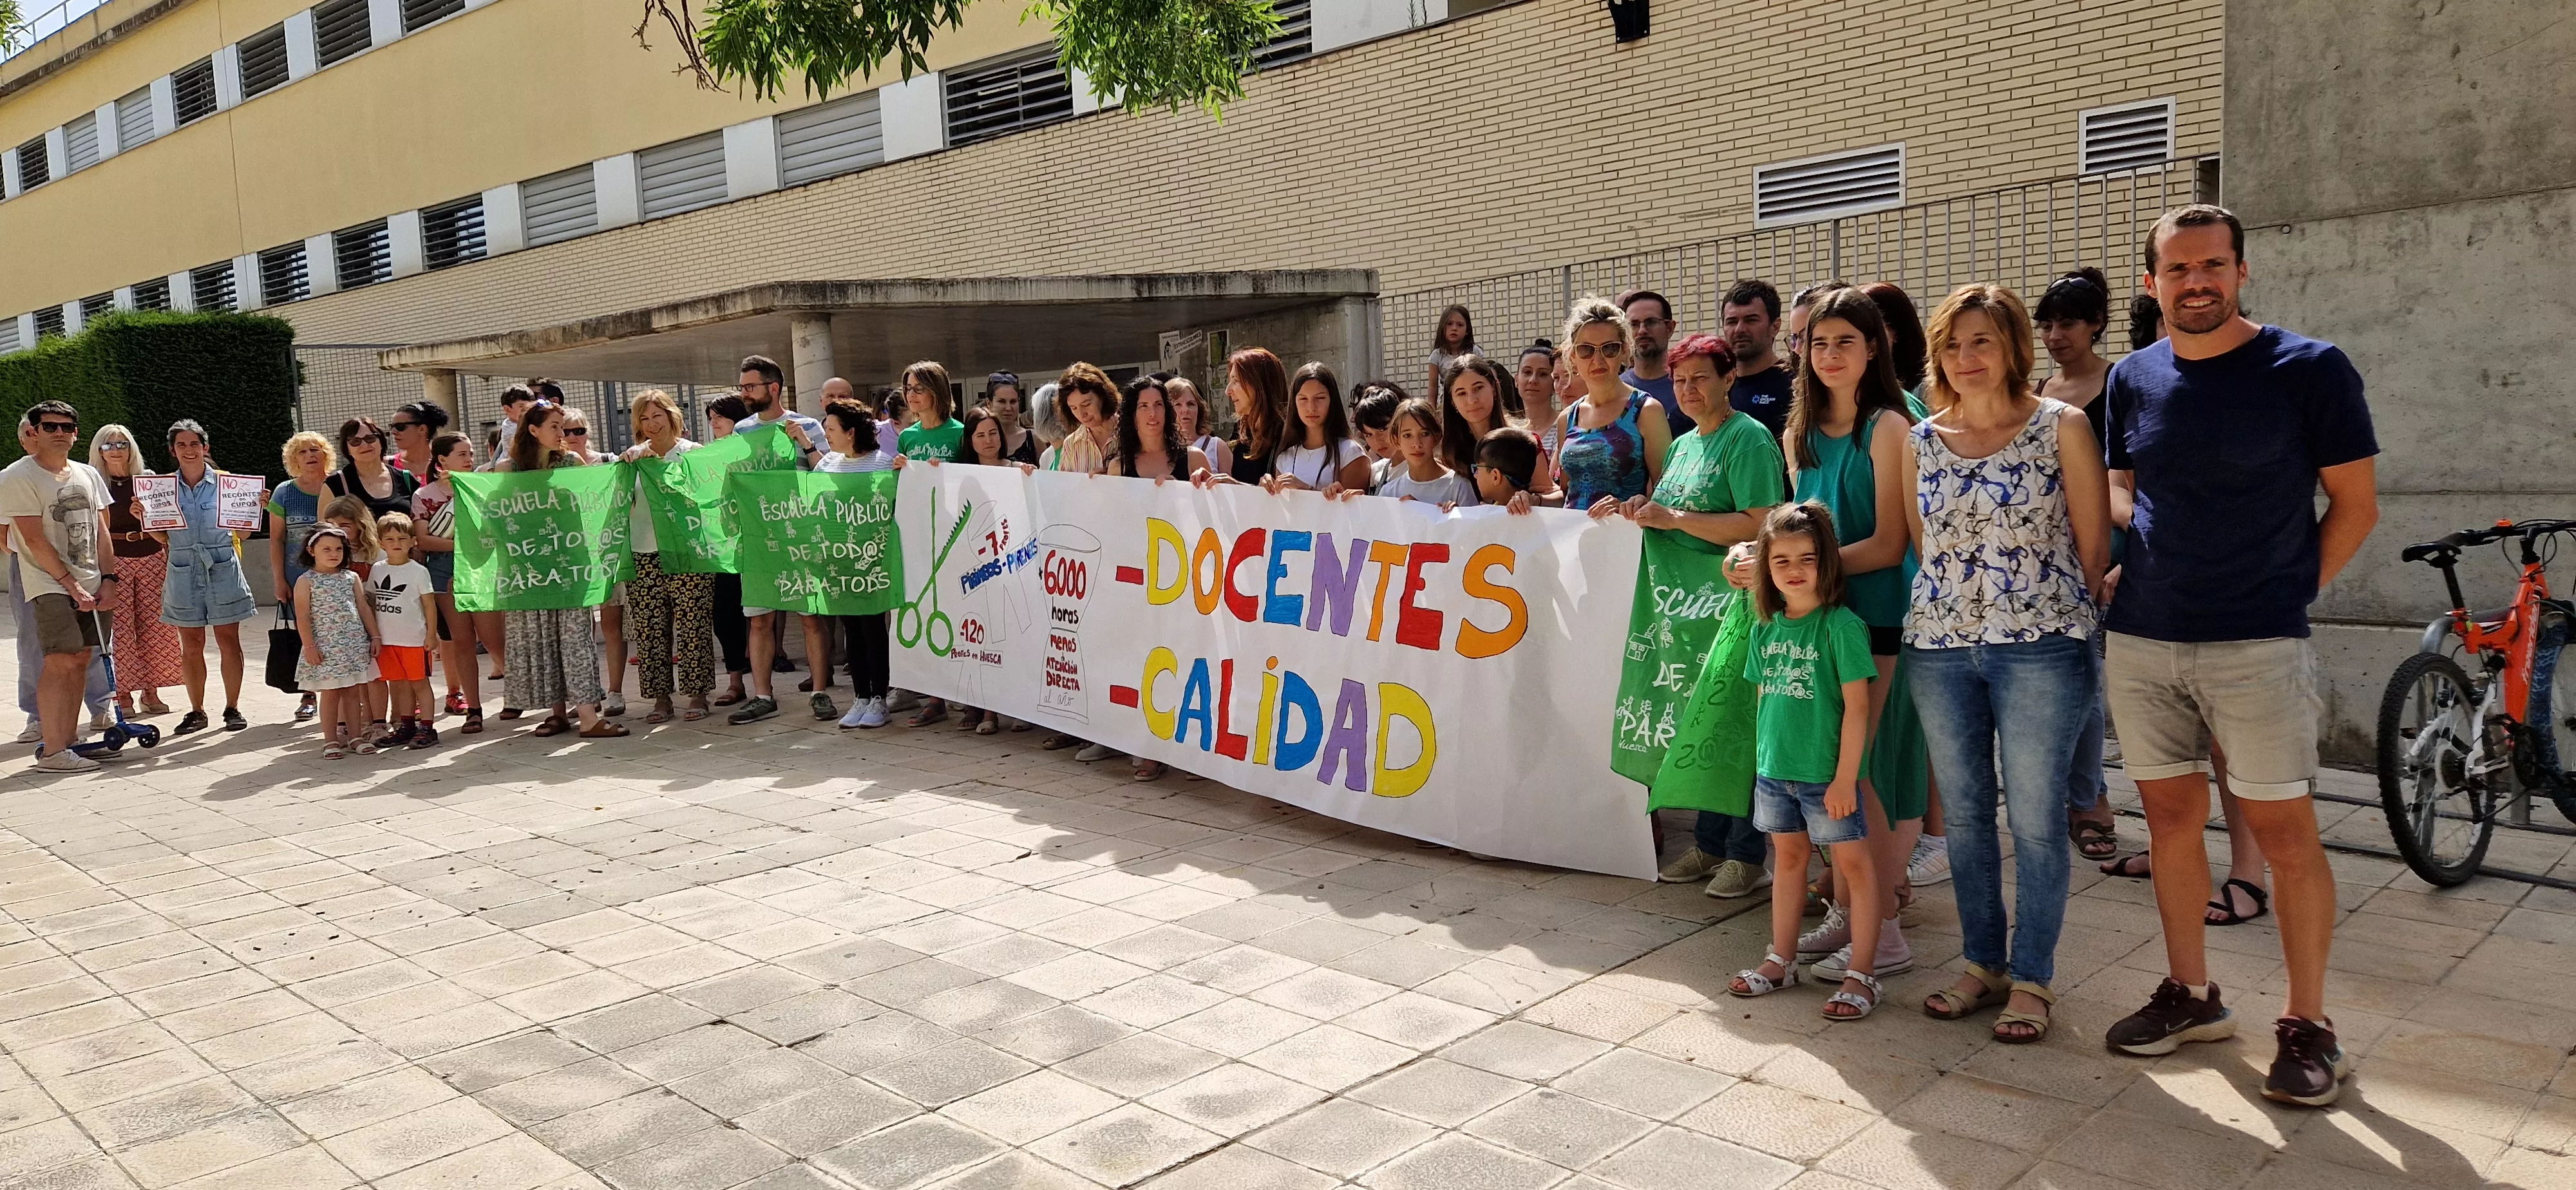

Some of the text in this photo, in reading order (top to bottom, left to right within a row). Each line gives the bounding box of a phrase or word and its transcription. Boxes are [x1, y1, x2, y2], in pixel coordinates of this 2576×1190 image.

[138, 479, 153, 492] NO
[222, 477, 238, 489] NO
[139, 490, 175, 501] RECORTES
[222, 491, 261, 499] RECORTES
[761, 494, 891, 526] ESCUELA PÚBLIC
[506, 528, 625, 556] DE TOD@S
[787, 544, 811, 562] DE
[496, 568, 562, 593] PARA
[780, 576, 831, 596] PARA
[1051, 596, 1079, 624] horas
[1653, 585, 1732, 620] SCUEL
[960, 618, 984, 645] -120
[980, 650, 1001, 665] HUESCA
[1653, 661, 1687, 692] DE
[1044, 688, 1052, 703] al
[1621, 710, 1676, 748] PAR
[1618, 739, 1648, 753] Huesca
